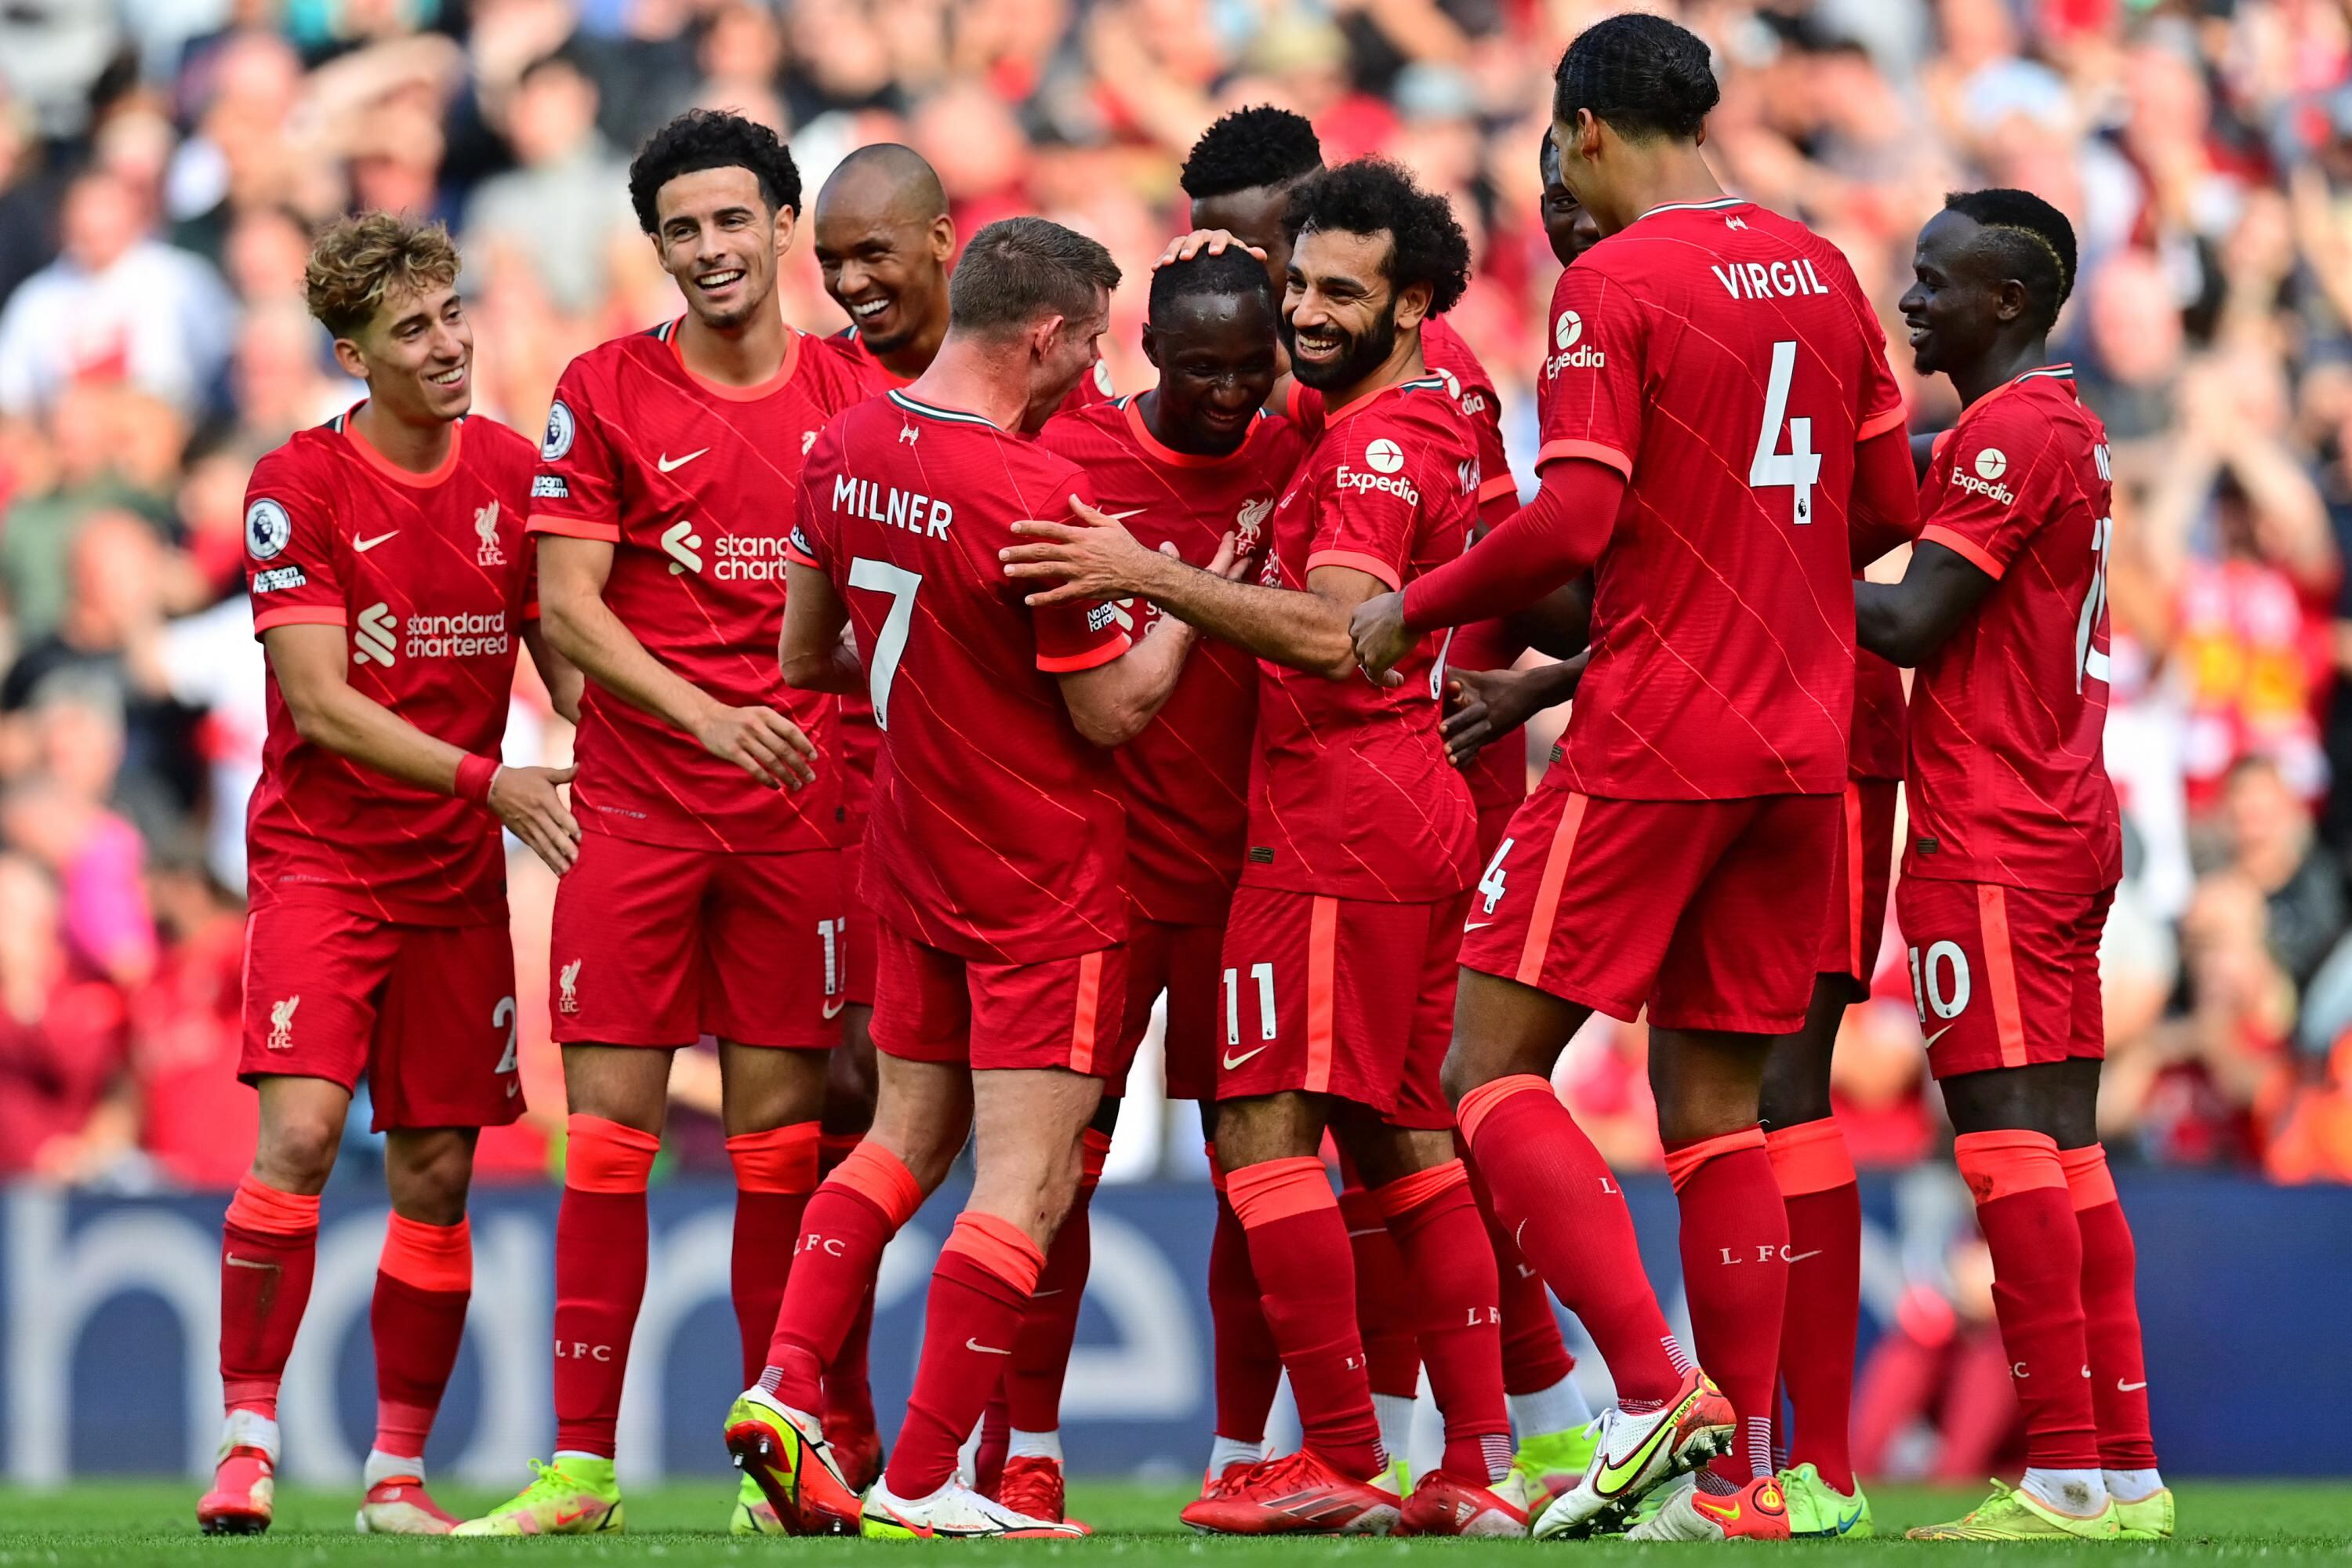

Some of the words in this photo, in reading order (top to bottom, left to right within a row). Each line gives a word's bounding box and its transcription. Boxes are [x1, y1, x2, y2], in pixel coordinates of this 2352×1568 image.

[1711, 259, 1829, 299] VIRGIL
[1749, 340, 1823, 524] 4
[832, 474, 953, 542] MILNER
[1337, 465, 1419, 507] Expedia
[1951, 466, 2014, 506] Expedia
[405, 632, 508, 658] chartered
[406, 610, 506, 636] standard
[848, 556, 923, 732] 7
[1477, 837, 1515, 915] 4
[1223, 963, 1276, 1045] 11
[1908, 940, 1971, 1023] 10
[1670, 1393, 1698, 1426] TIEMPO
